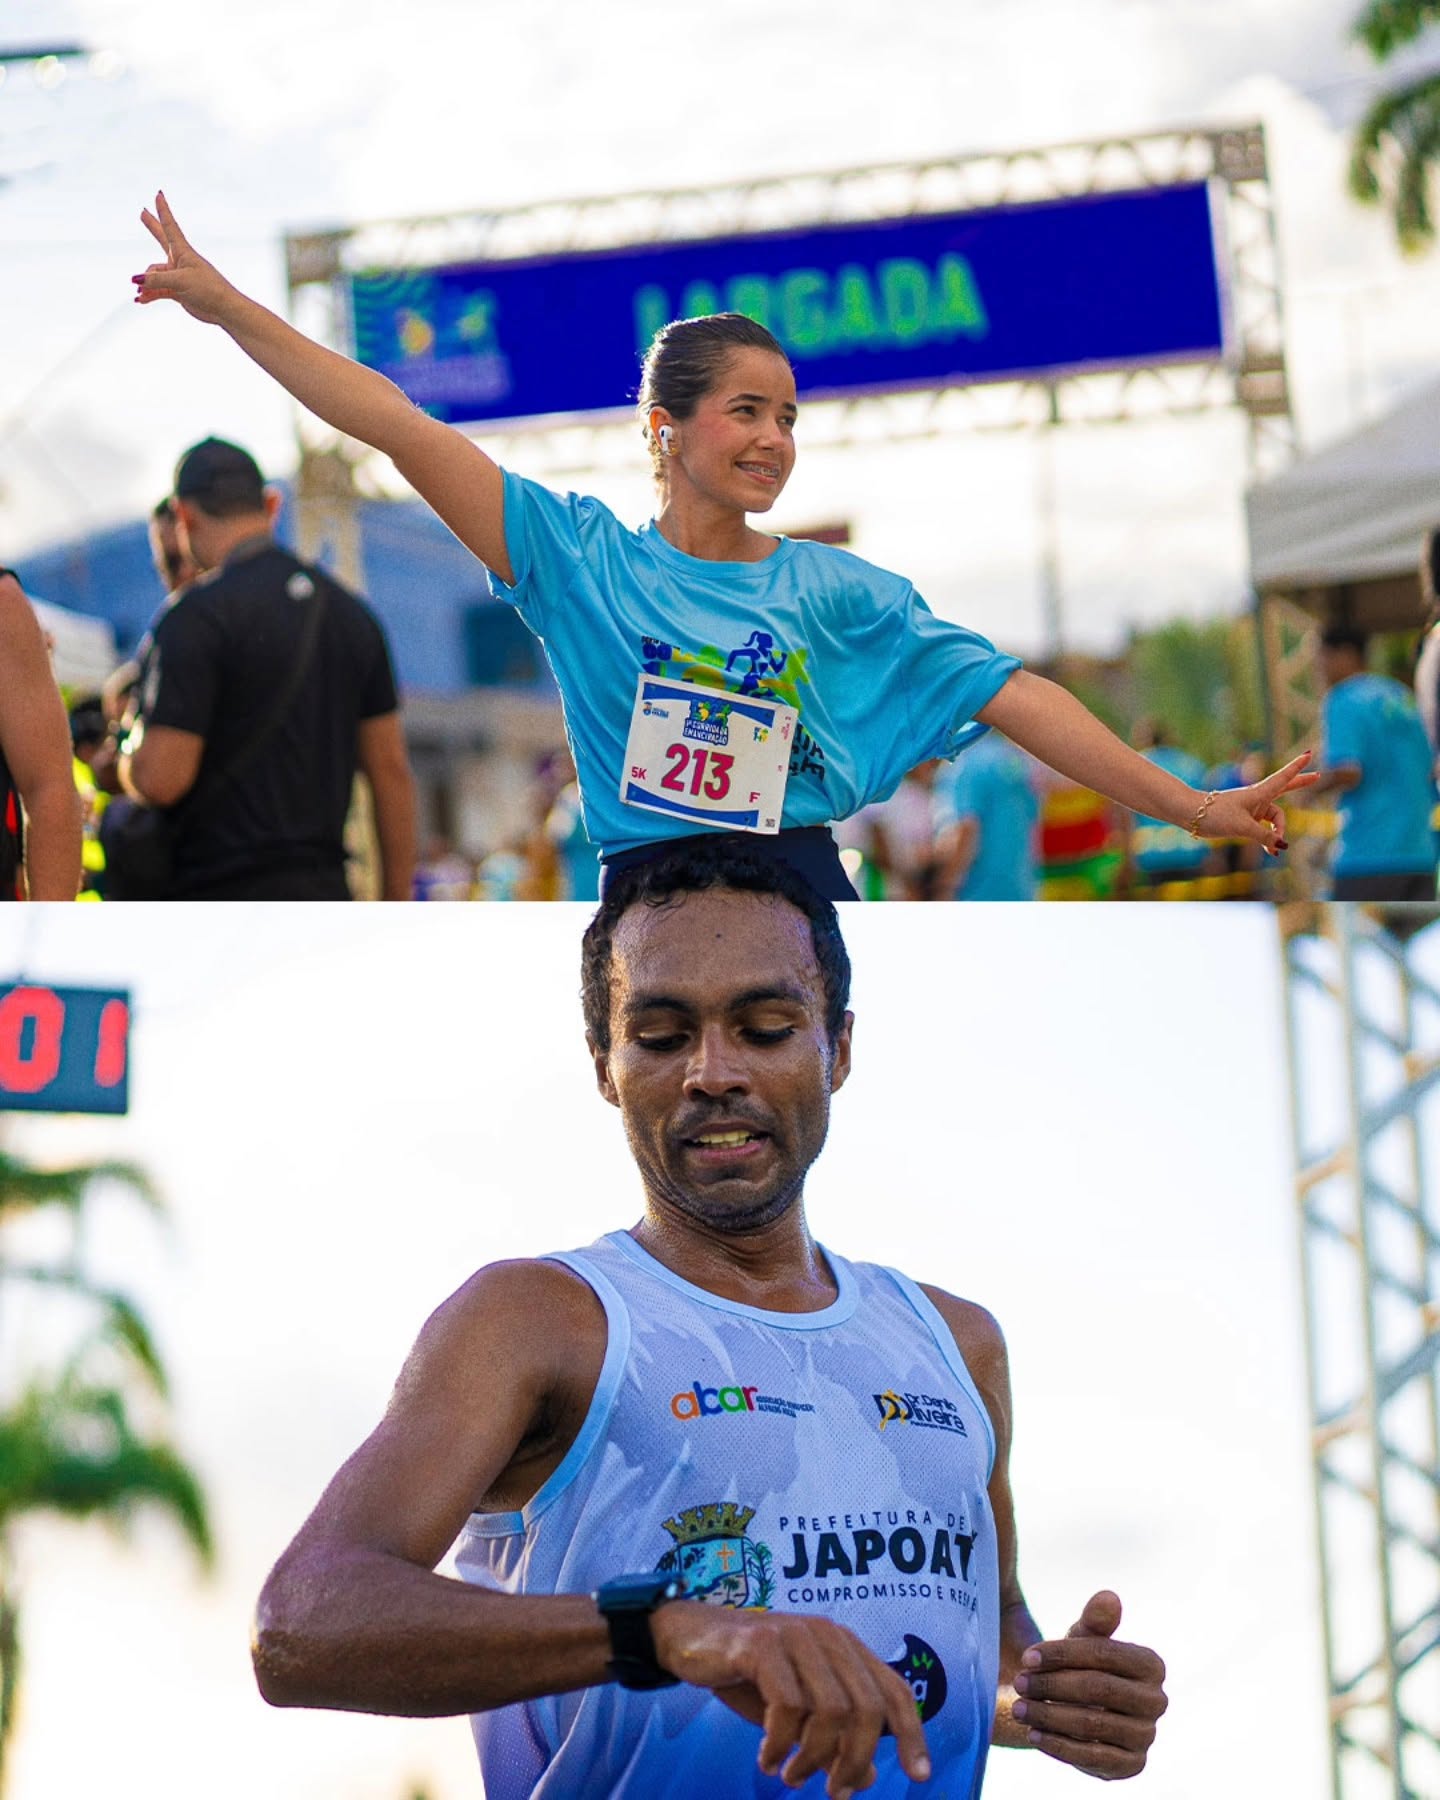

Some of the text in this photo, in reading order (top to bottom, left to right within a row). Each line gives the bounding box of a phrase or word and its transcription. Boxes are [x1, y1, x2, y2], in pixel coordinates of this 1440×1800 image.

[631, 766, 648, 781] 5K
[661, 743, 735, 801] 213
[749, 791, 761, 804] F
[779, 1510, 965, 1531] PREFEITURA DE
[783, 1526, 977, 1583] JAPOAT
[788, 1583, 932, 1604] COMPROMISSO
[937, 1585, 944, 1600] E
